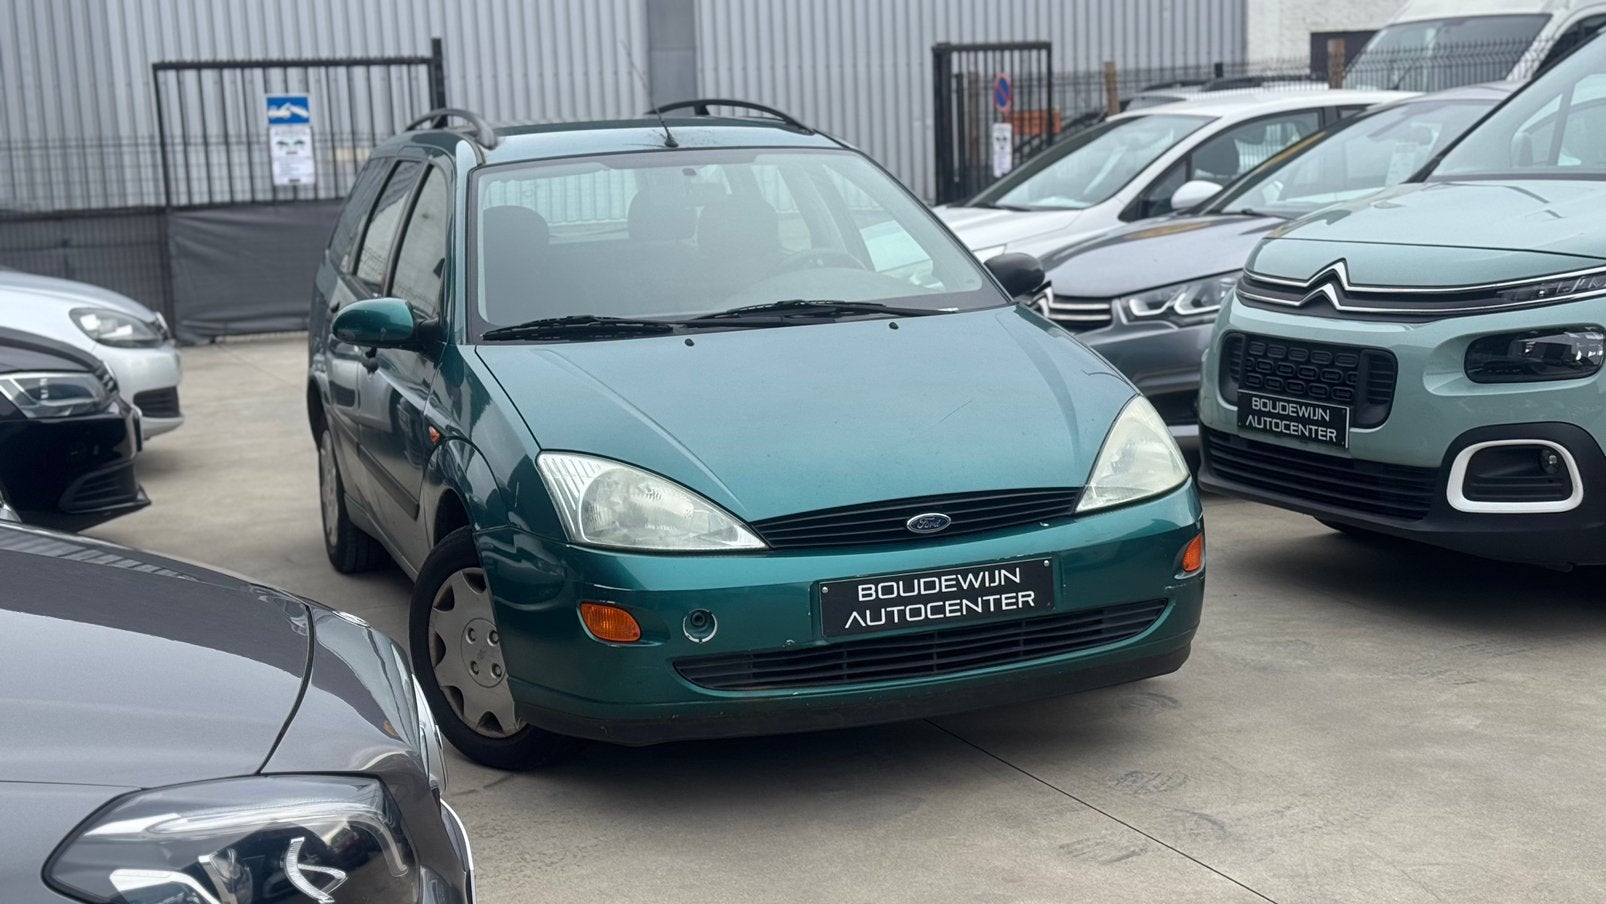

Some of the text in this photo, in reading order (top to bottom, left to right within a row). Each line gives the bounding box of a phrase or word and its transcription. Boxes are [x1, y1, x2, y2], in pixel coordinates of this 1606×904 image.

[1251, 397, 1330, 422] BOUDEWIJN
[1245, 414, 1337, 442] AUTOCENTER
[917, 518, 941, 529] Ford
[857, 567, 1020, 602] BOUDEWIJN
[844, 590, 1035, 629] AUTOCENTER
